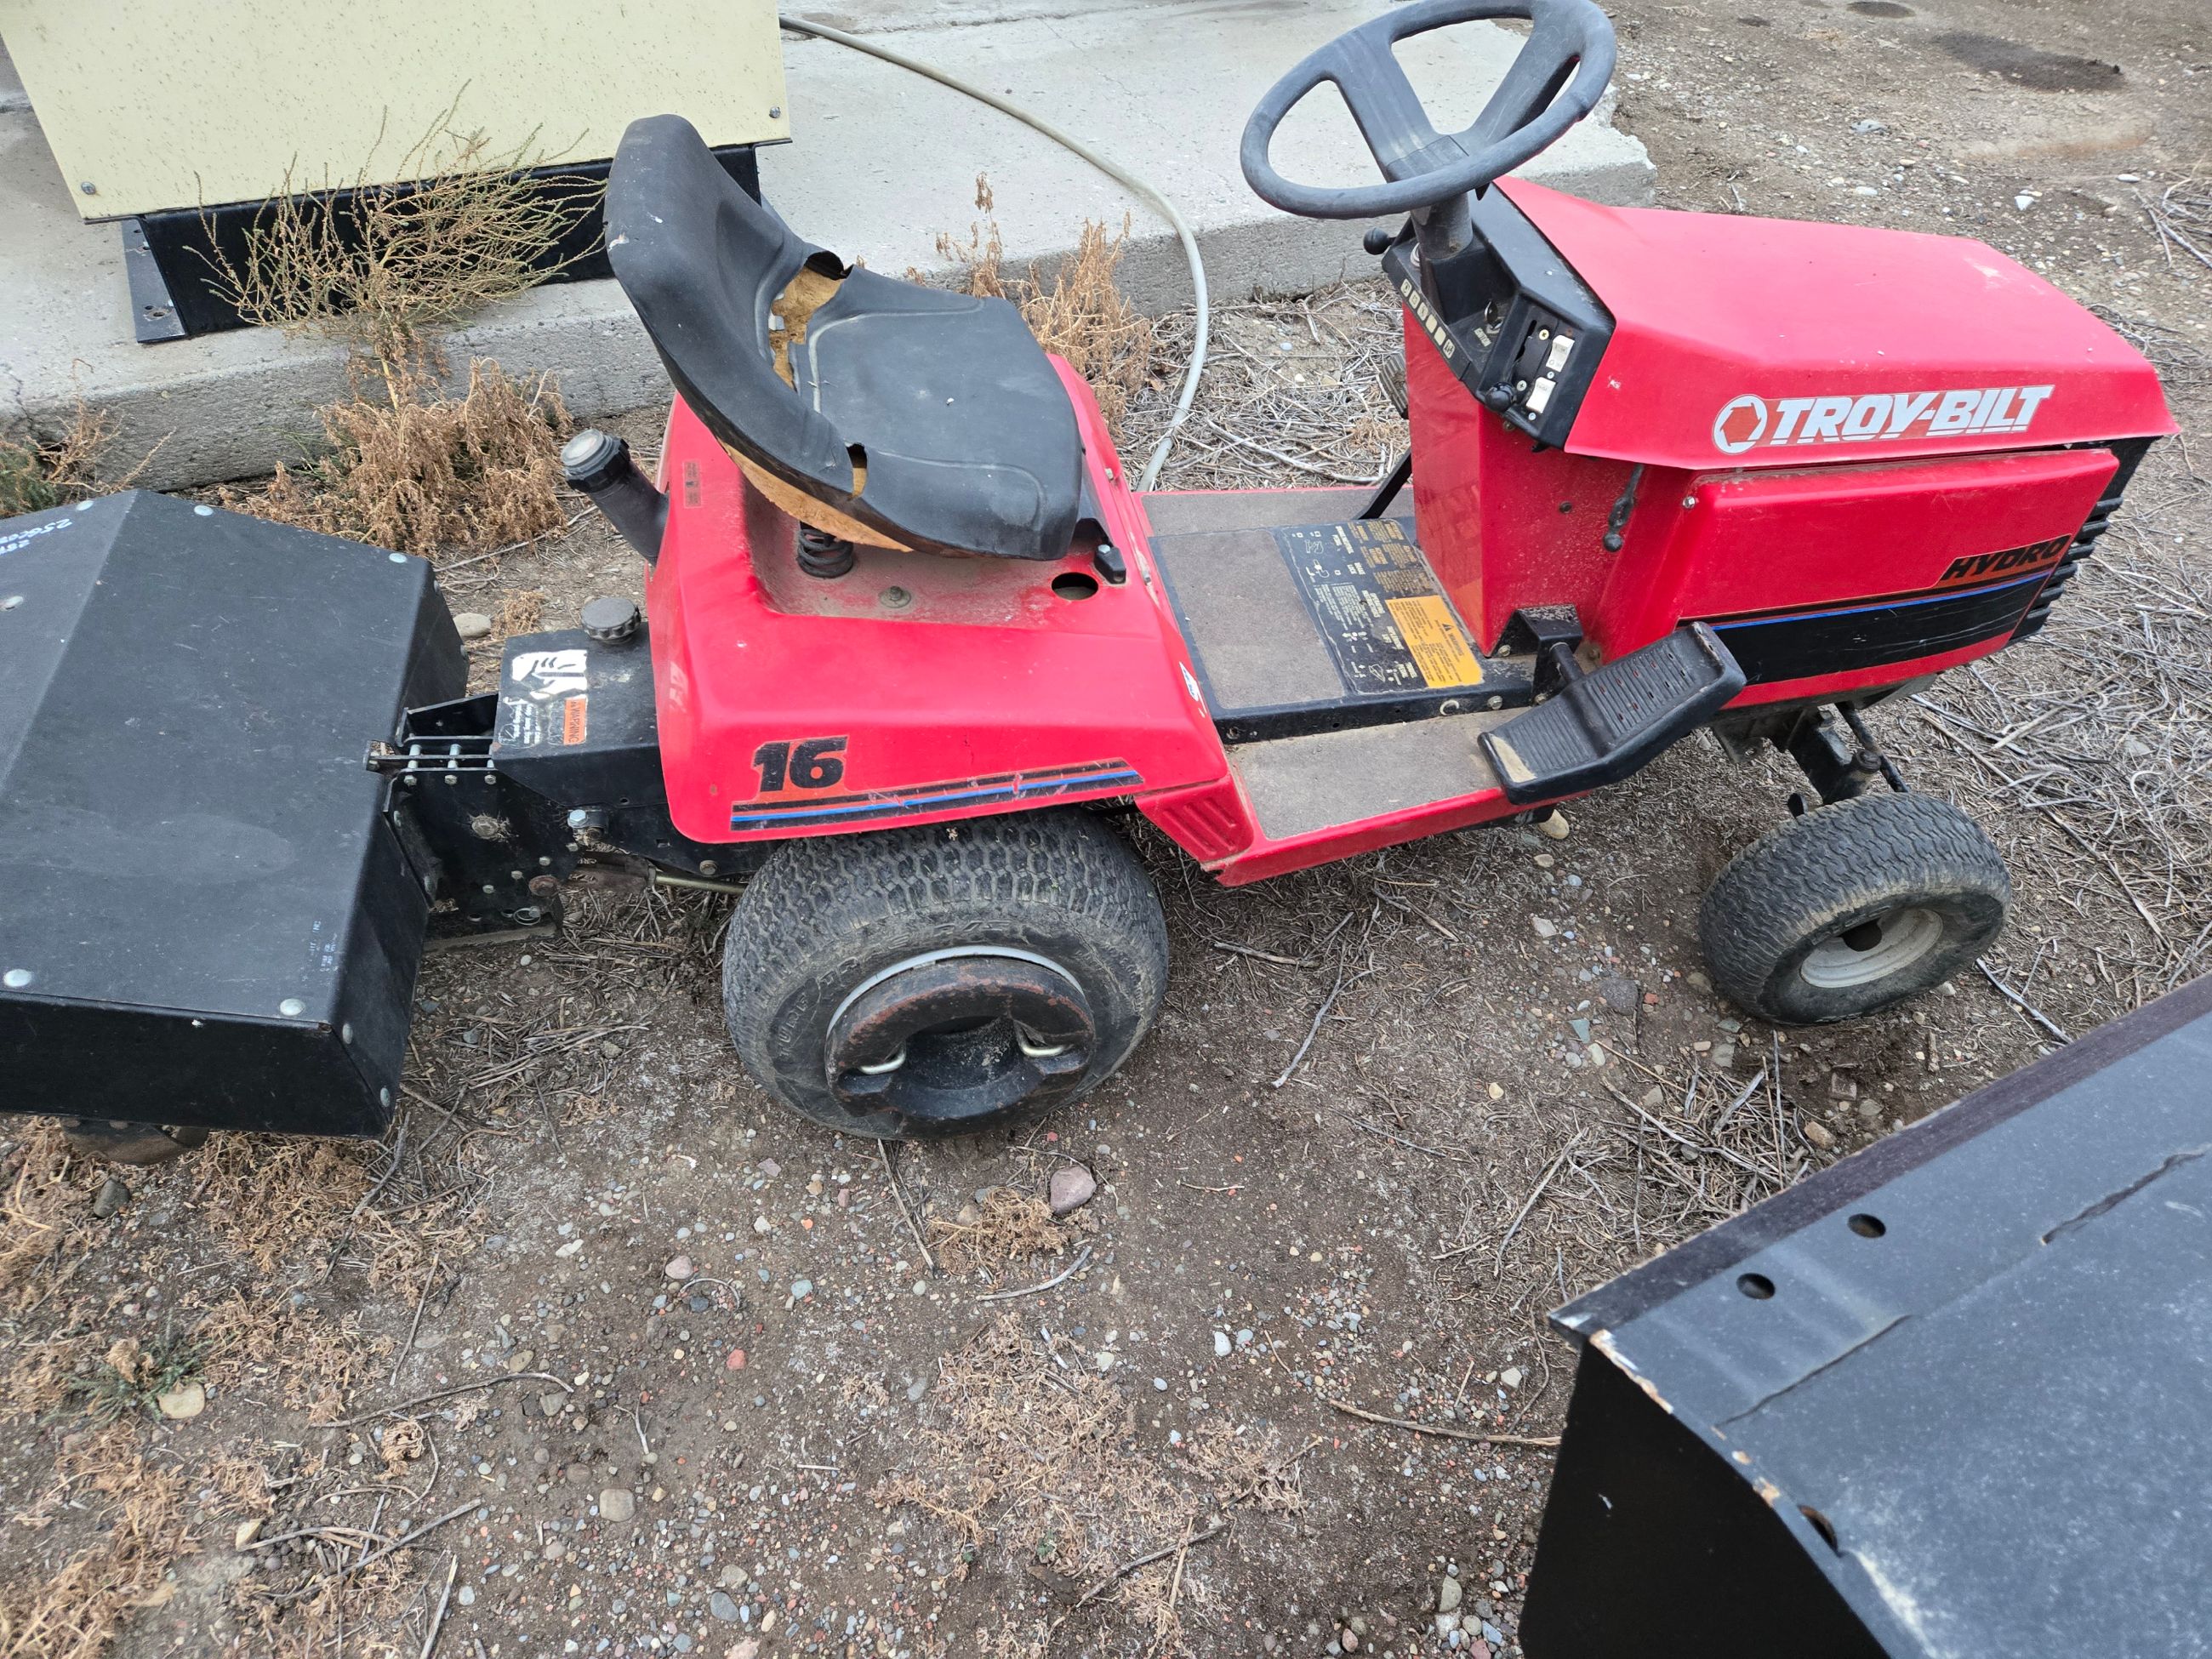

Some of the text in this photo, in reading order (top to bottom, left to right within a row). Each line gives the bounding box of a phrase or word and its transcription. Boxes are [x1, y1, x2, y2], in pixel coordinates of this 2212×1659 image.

[1770, 385, 2054, 445] TROY-BILT
[1940, 534, 2071, 580] HYDRO
[567, 705, 581, 743] WARNING
[754, 737, 847, 791] 16
